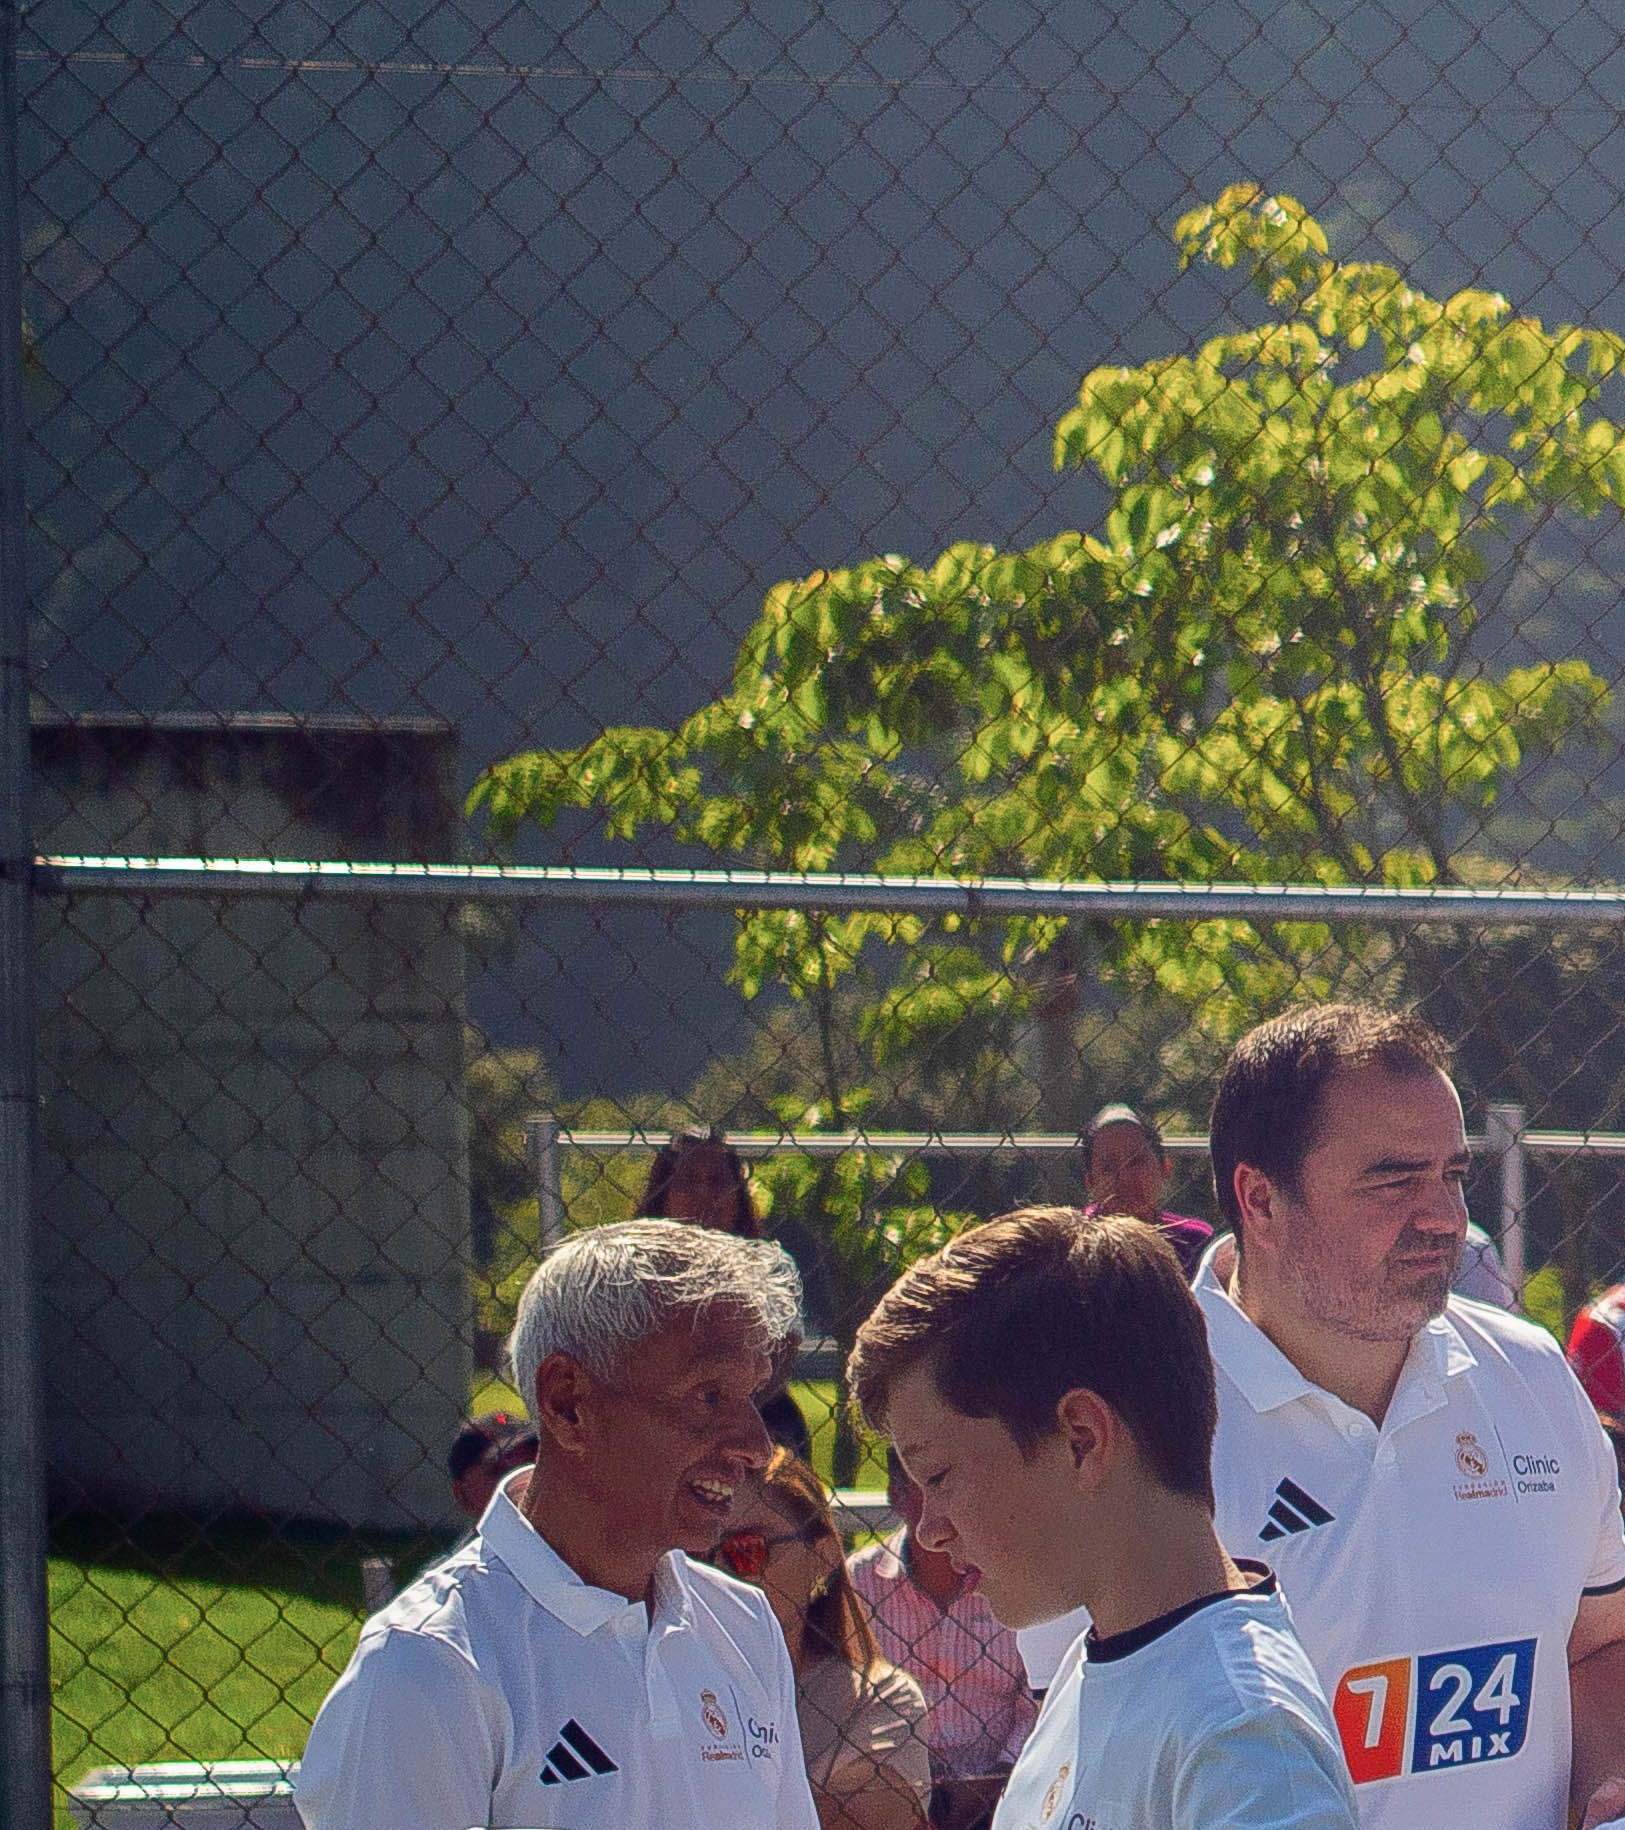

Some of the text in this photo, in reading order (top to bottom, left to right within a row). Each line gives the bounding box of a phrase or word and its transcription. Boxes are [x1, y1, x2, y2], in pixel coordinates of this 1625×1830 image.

[1512, 1454, 1560, 1475] Clinic
[1517, 1480, 1555, 1494] Orizaba
[1428, 1653, 1521, 1737] 24
[1428, 1730, 1512, 1766] MIX
